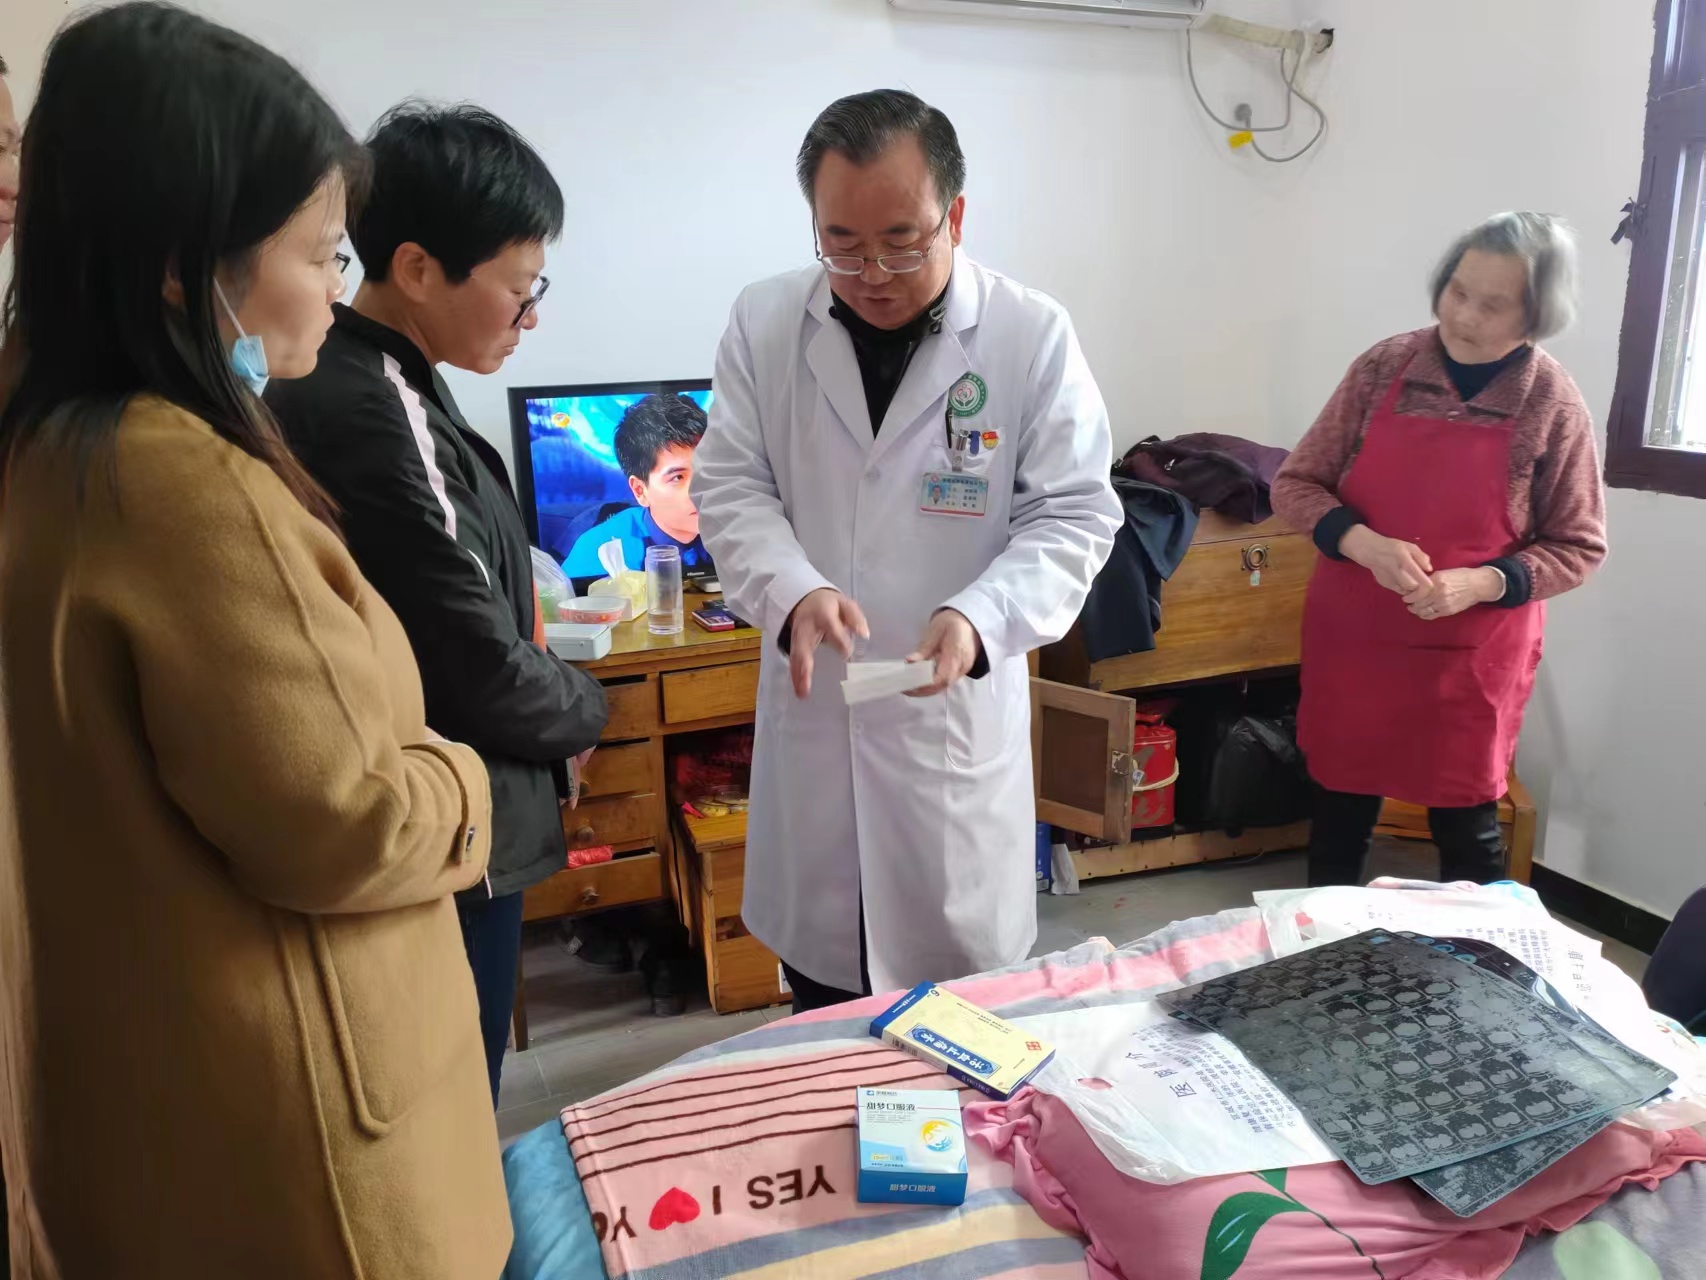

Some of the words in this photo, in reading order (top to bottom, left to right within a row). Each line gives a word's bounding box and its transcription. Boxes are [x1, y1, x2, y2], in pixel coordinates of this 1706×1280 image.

[866, 1101, 916, 1111] 甜梦口服液
[747, 1165, 837, 1210] YES
[889, 1183, 937, 1193] 甜梦口服液
[712, 1185, 722, 1216] I
